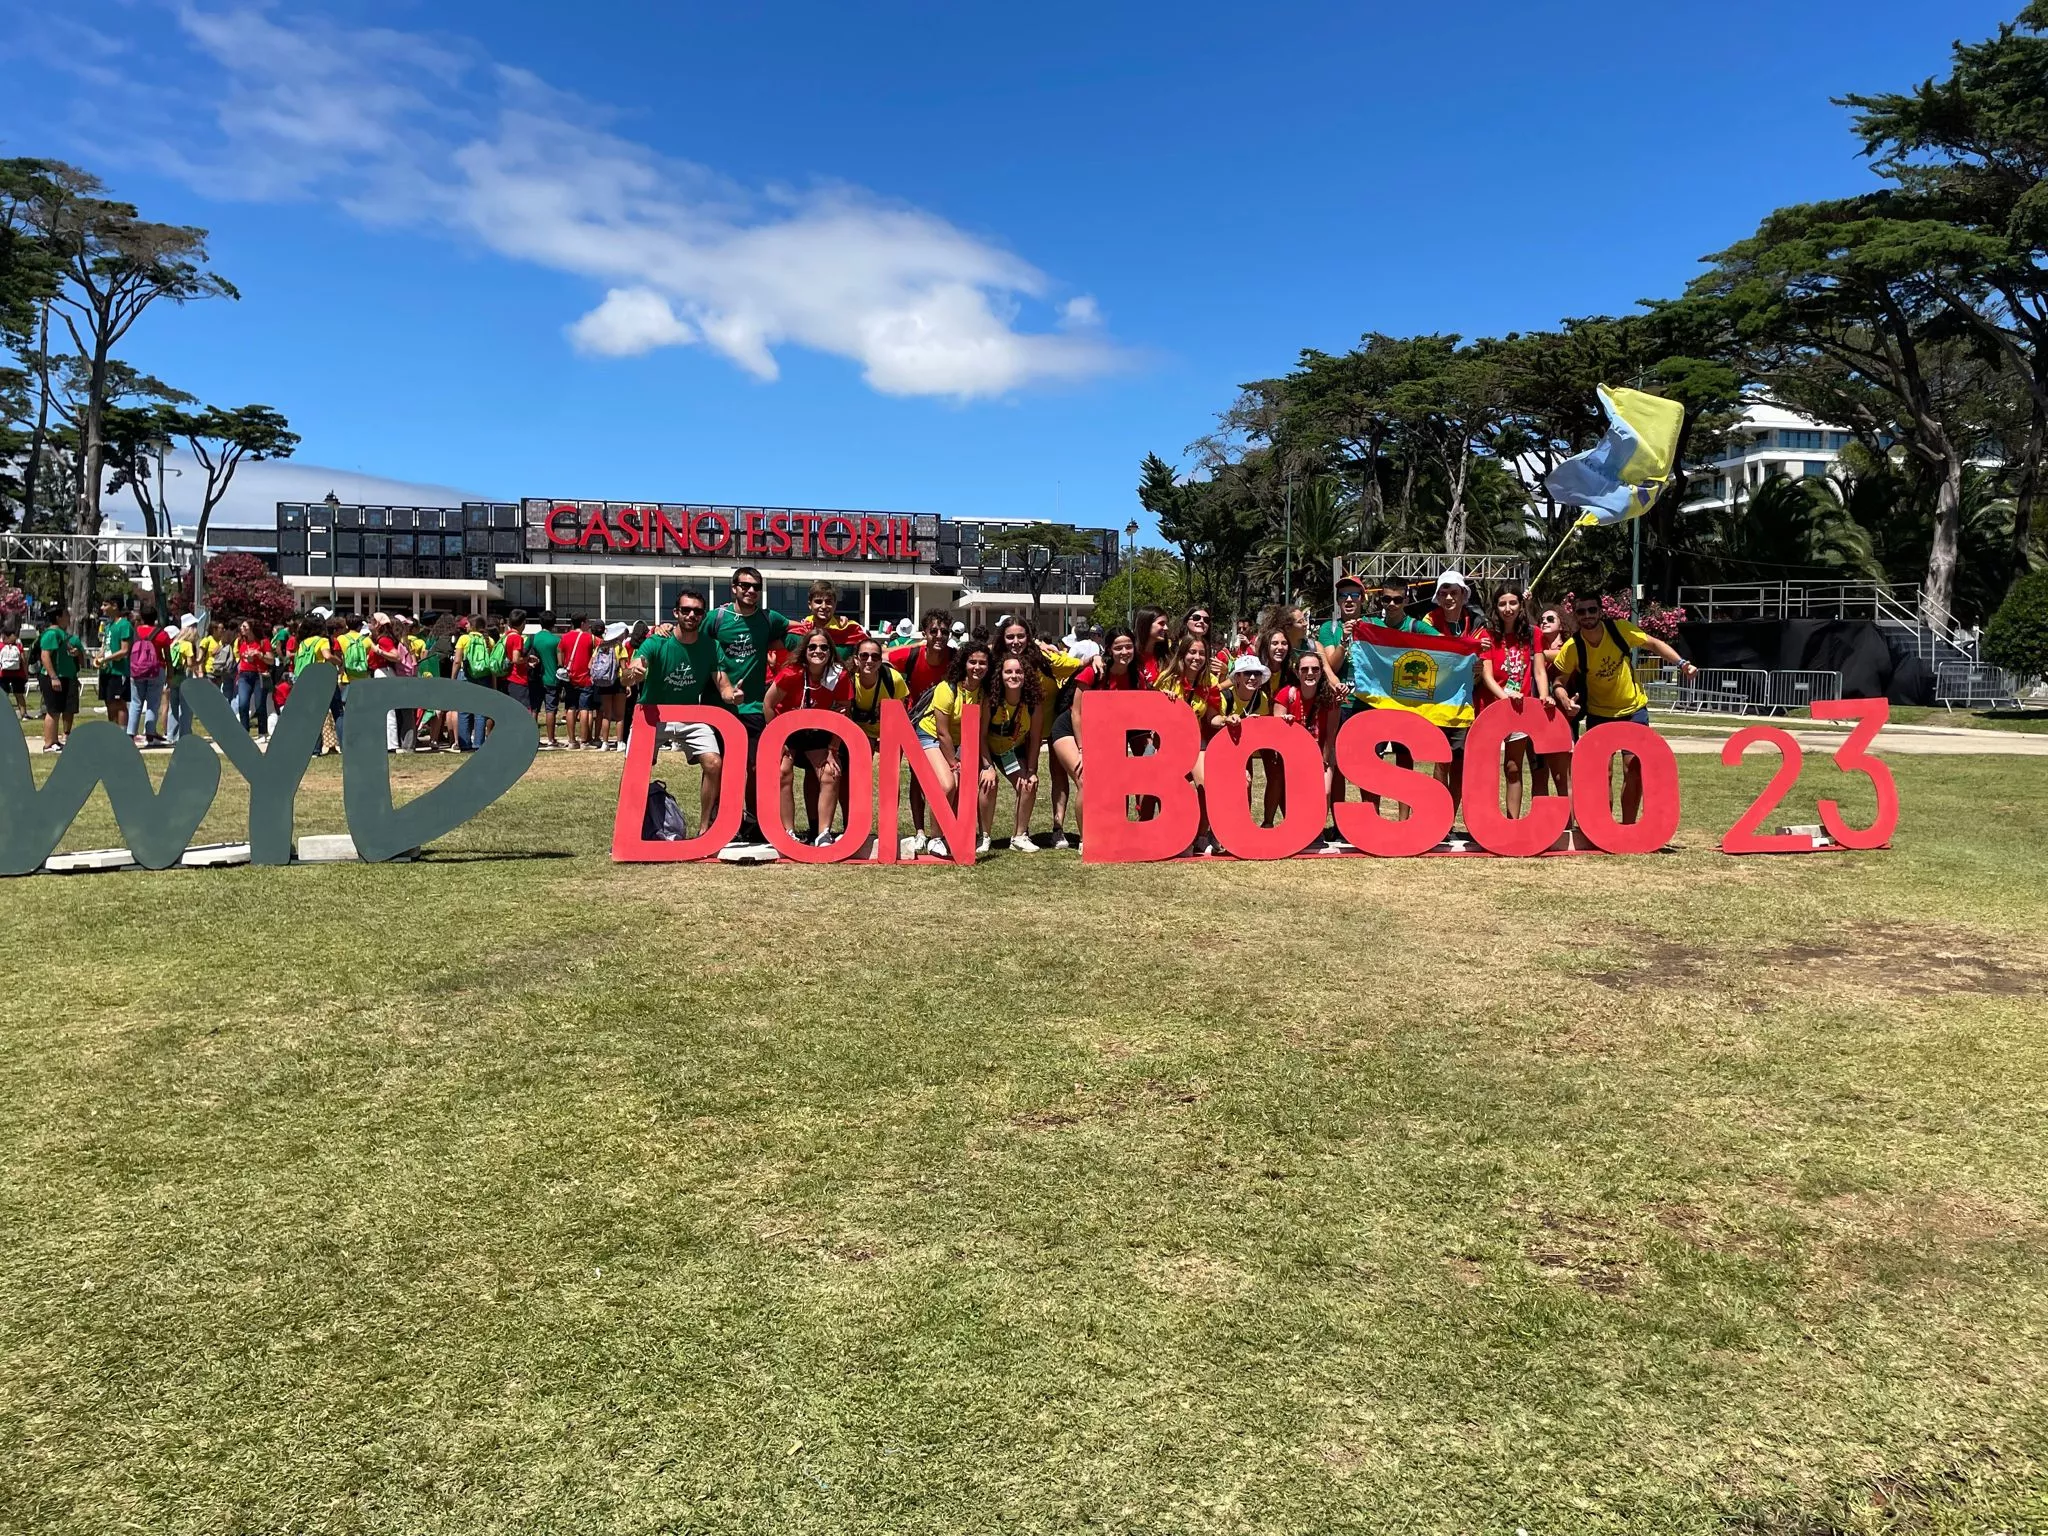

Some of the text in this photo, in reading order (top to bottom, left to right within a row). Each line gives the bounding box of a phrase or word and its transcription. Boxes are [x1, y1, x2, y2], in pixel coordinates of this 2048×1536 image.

[545, 505, 921, 557] CASINO ESTORIL
[0, 663, 539, 876] WYD
[612, 699, 981, 866] DON
[1721, 697, 1900, 854] 23
